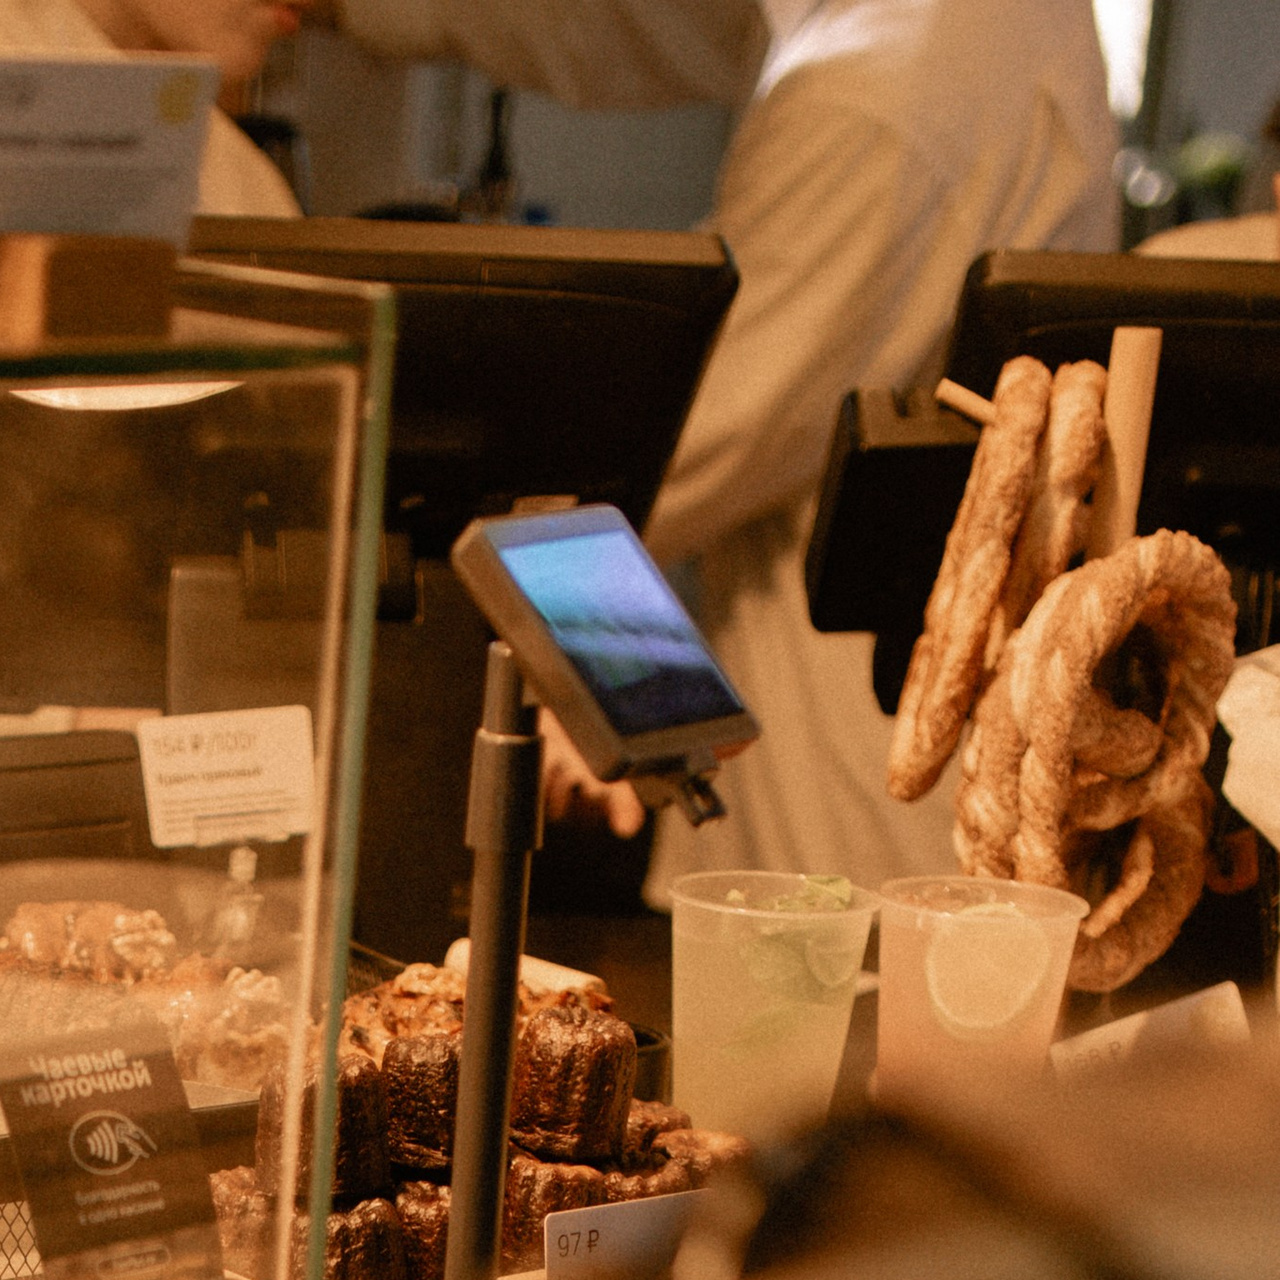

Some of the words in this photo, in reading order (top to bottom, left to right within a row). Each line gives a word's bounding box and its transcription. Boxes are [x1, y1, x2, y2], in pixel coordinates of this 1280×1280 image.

[29, 1047, 128, 1081] Чаевые
[20, 1059, 152, 1108] карточкой
[557, 1231, 581, 1258] 97
